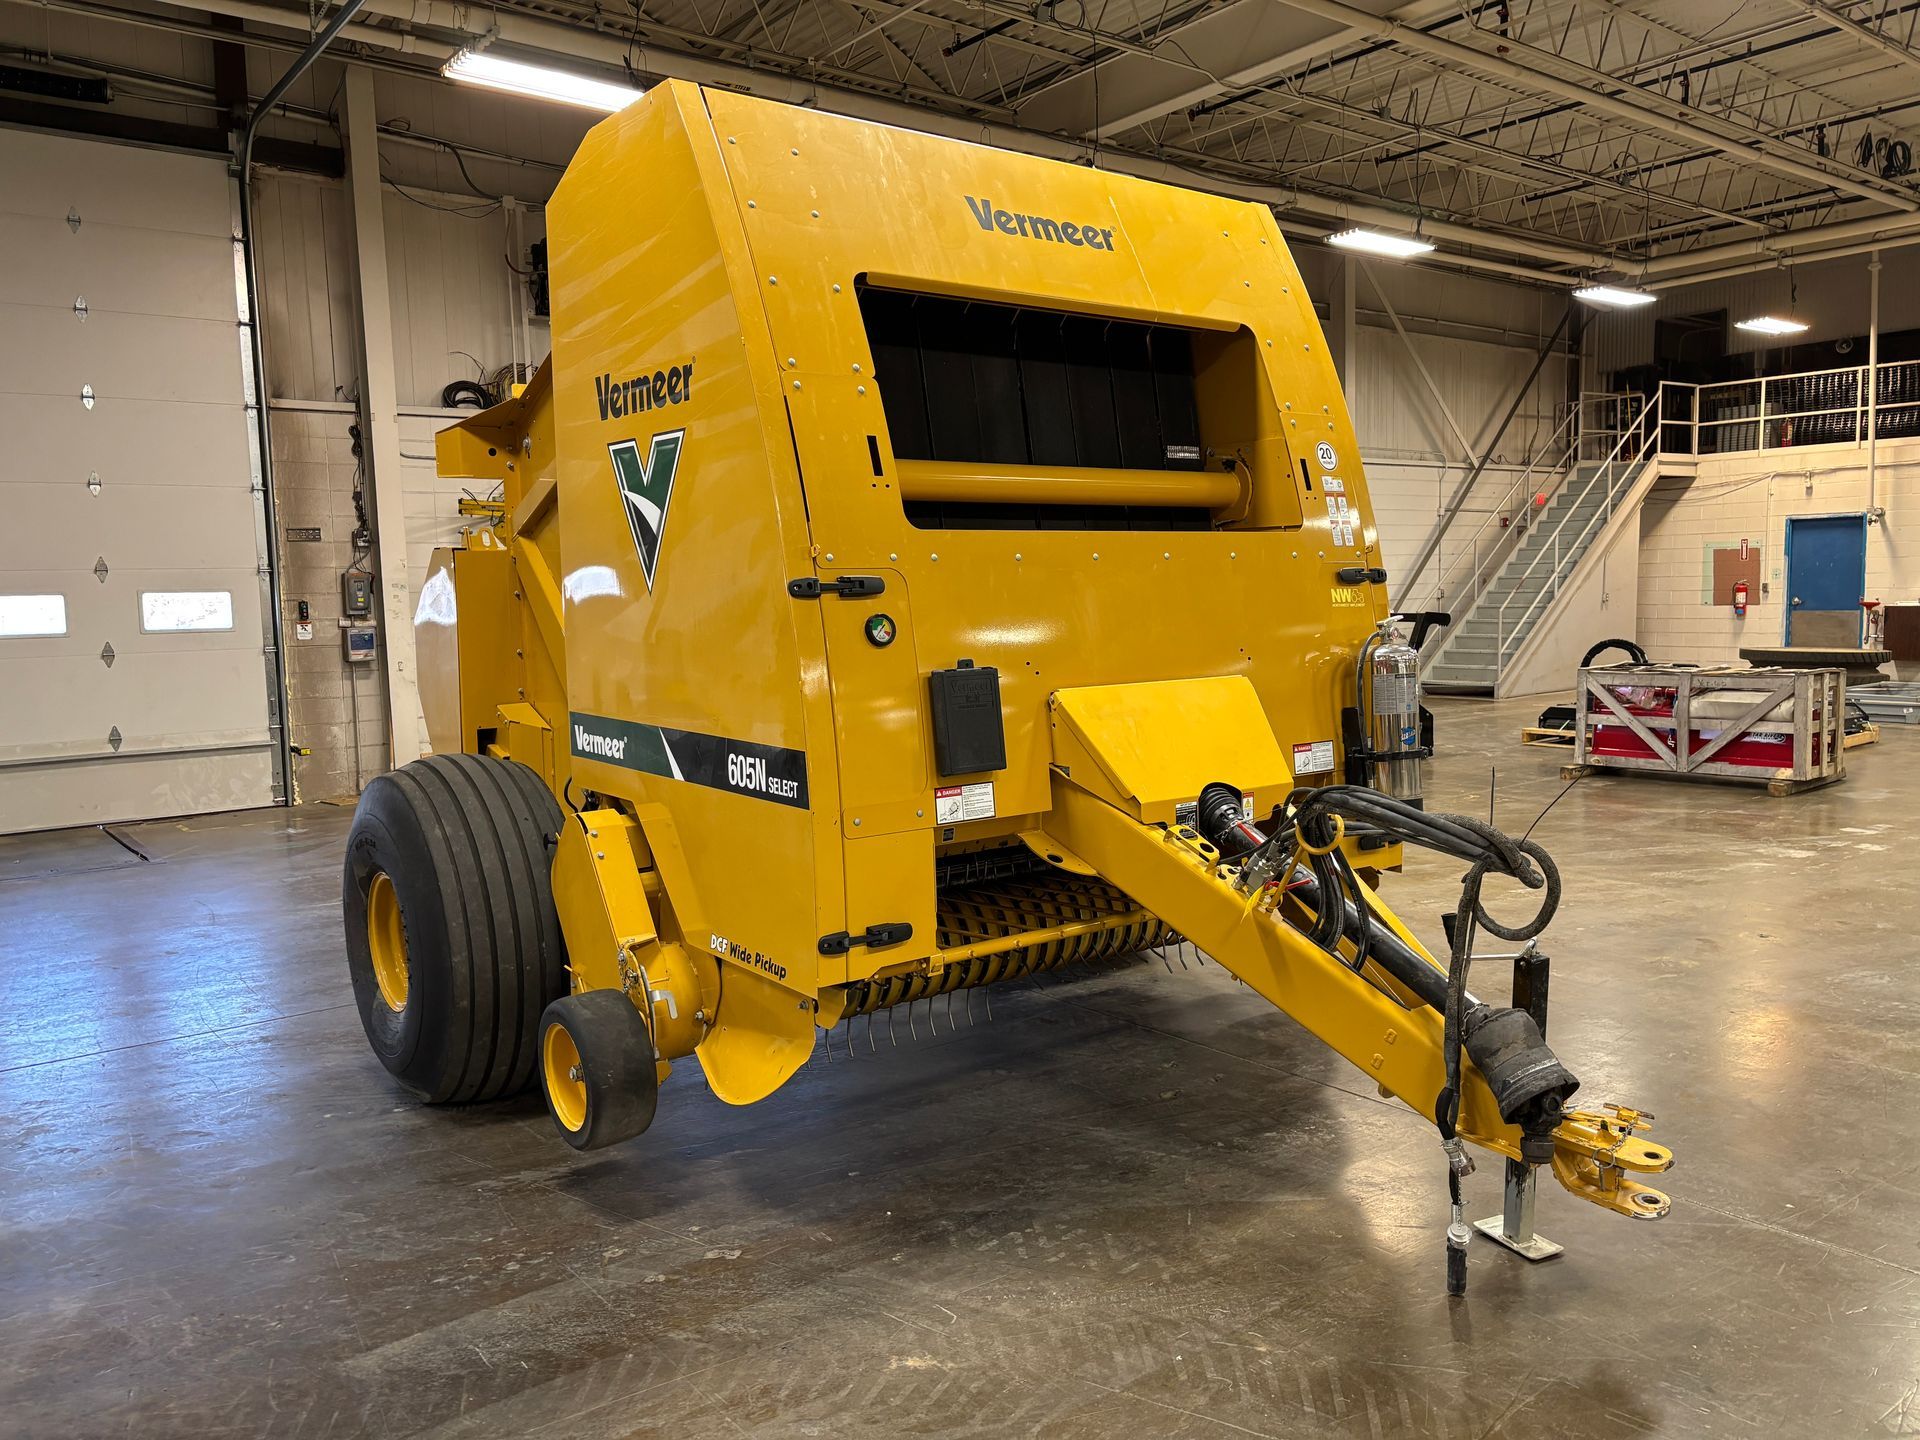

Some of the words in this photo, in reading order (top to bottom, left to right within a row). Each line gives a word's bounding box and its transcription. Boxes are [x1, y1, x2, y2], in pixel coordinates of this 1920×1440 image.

[1319, 447, 1333, 460] 20
[1330, 588, 1352, 603] NW
[728, 753, 767, 793] 605N
[768, 776, 799, 799] SELECT
[942, 788, 961, 796] DANGER
[710, 933, 728, 954] DCF
[730, 942, 752, 964] Wide
[754, 951, 787, 981] Pickup
